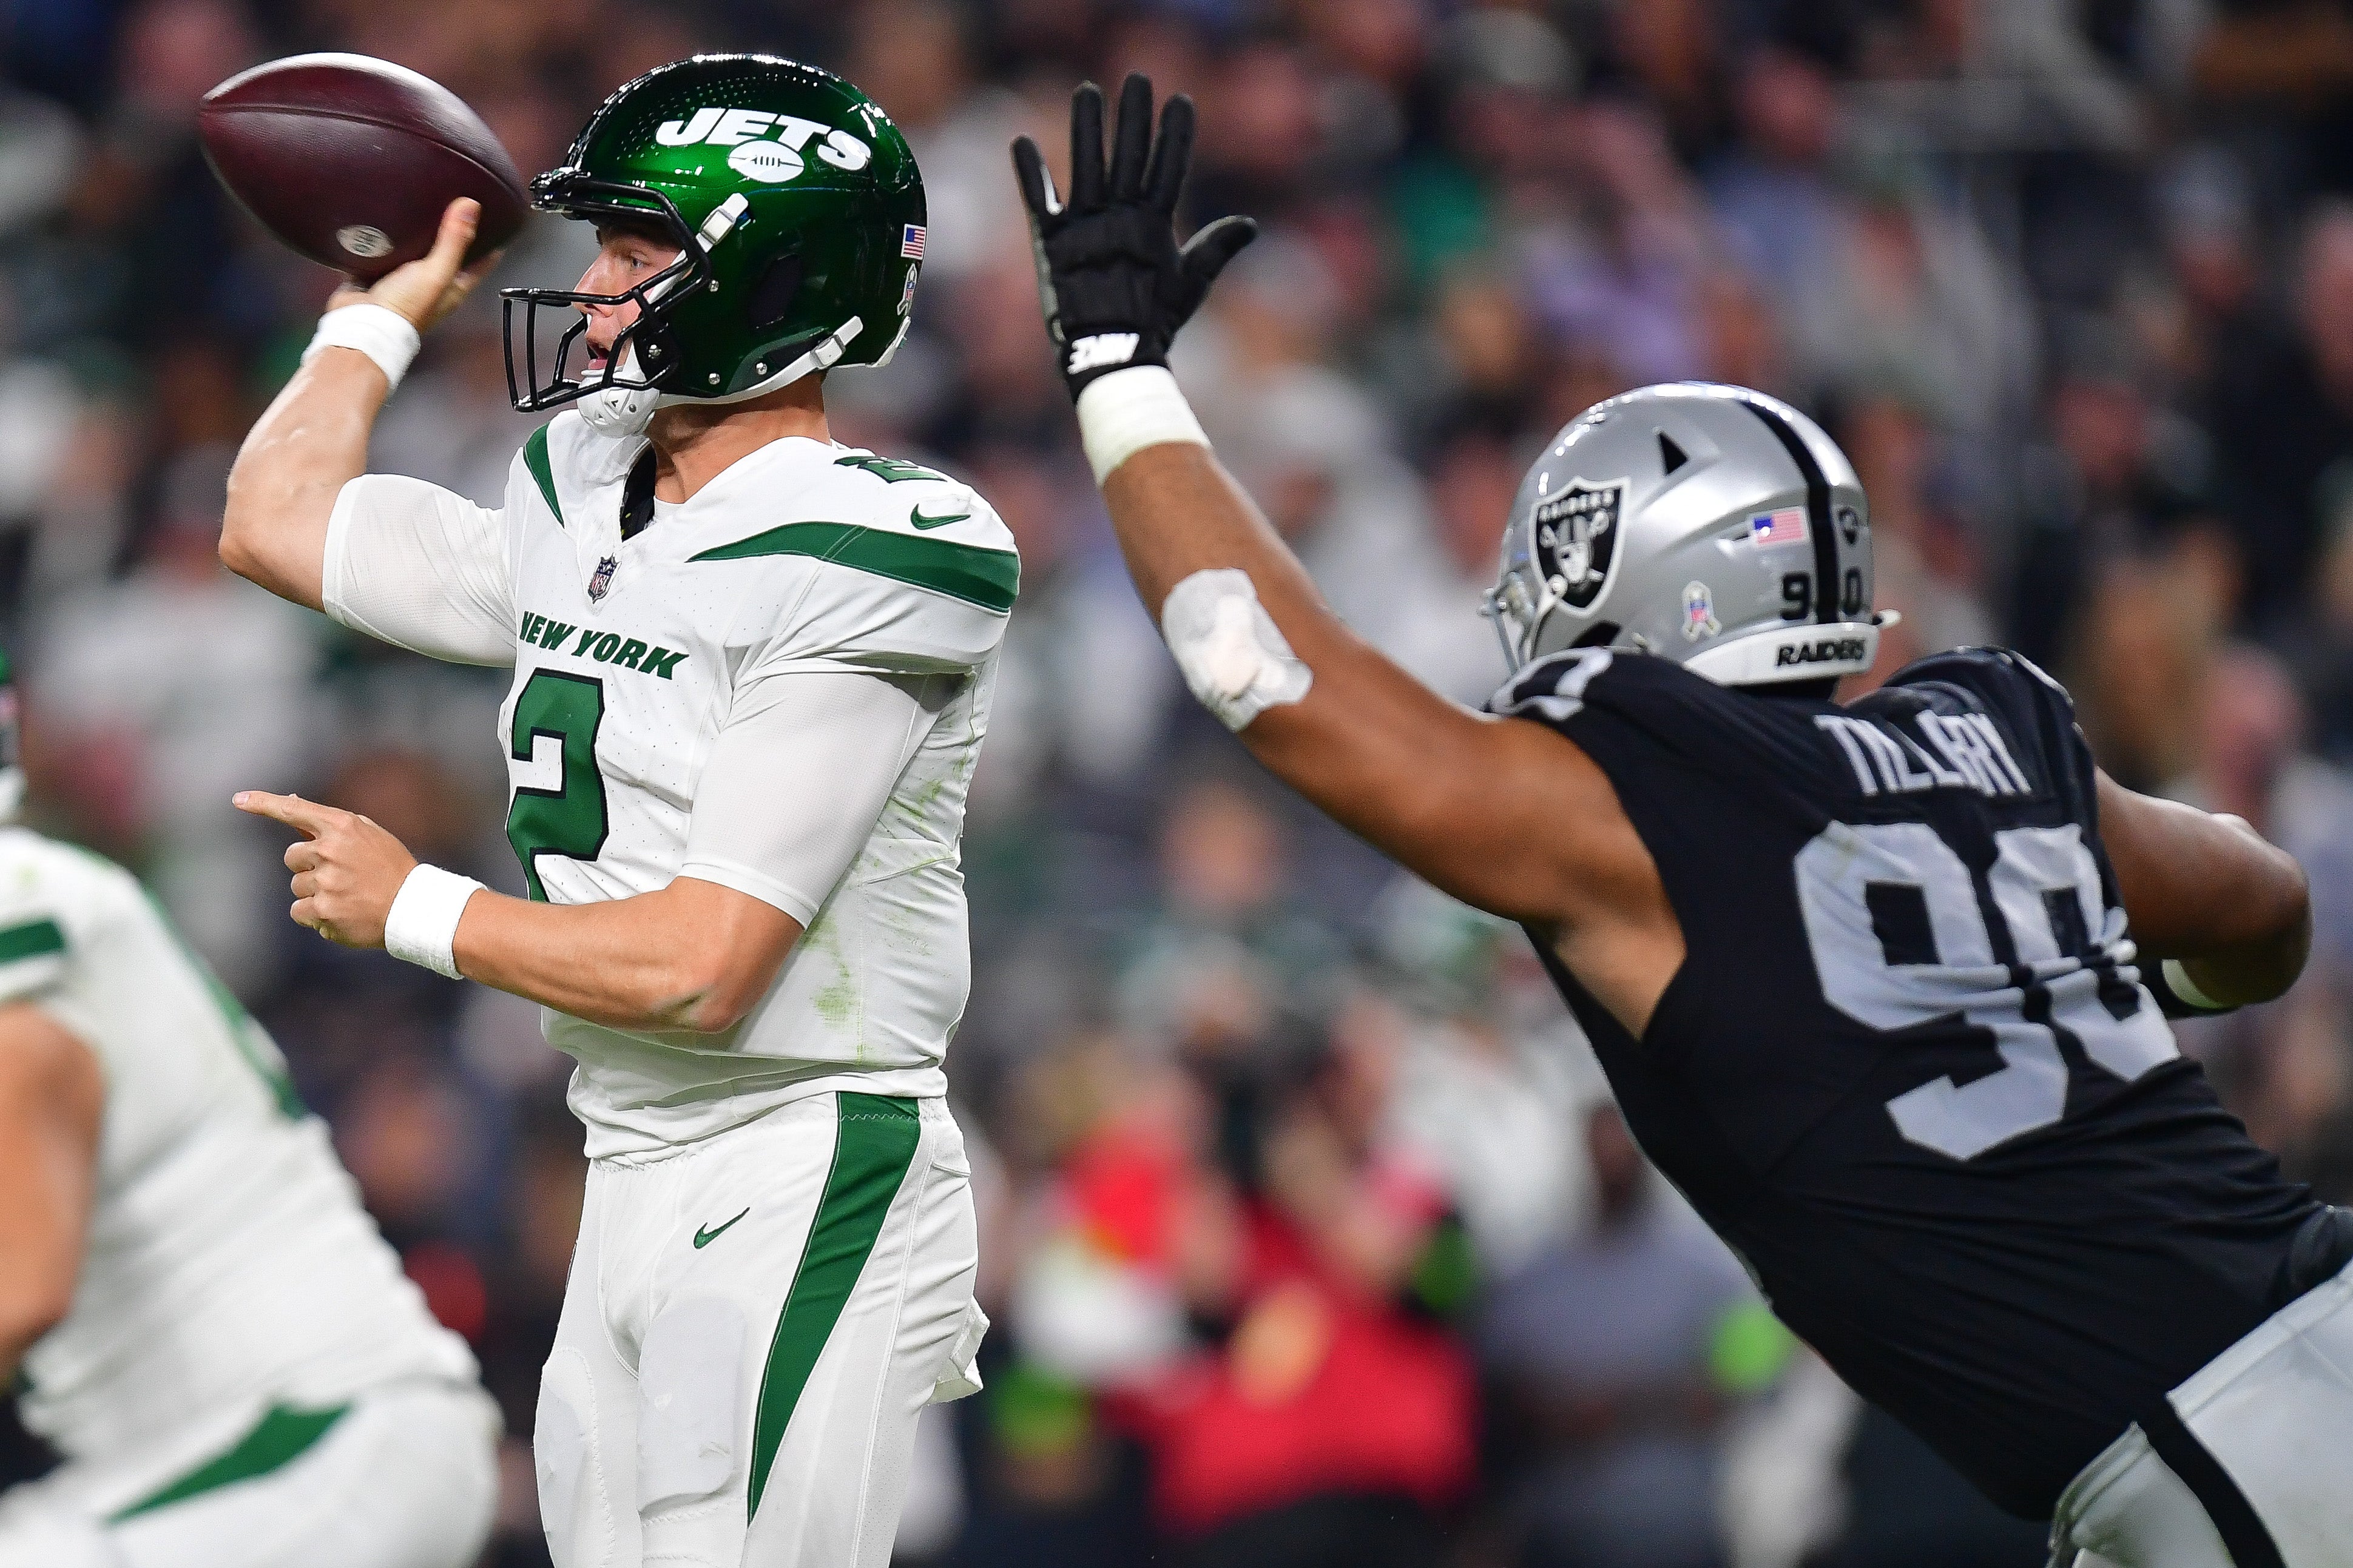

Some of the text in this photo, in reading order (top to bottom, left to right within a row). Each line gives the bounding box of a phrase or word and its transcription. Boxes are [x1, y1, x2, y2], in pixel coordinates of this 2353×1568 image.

[655, 107, 871, 171] JETS
[519, 611, 690, 680] NEW YORK
[506, 667, 609, 903] 2
[1793, 819, 2182, 1161] 90
